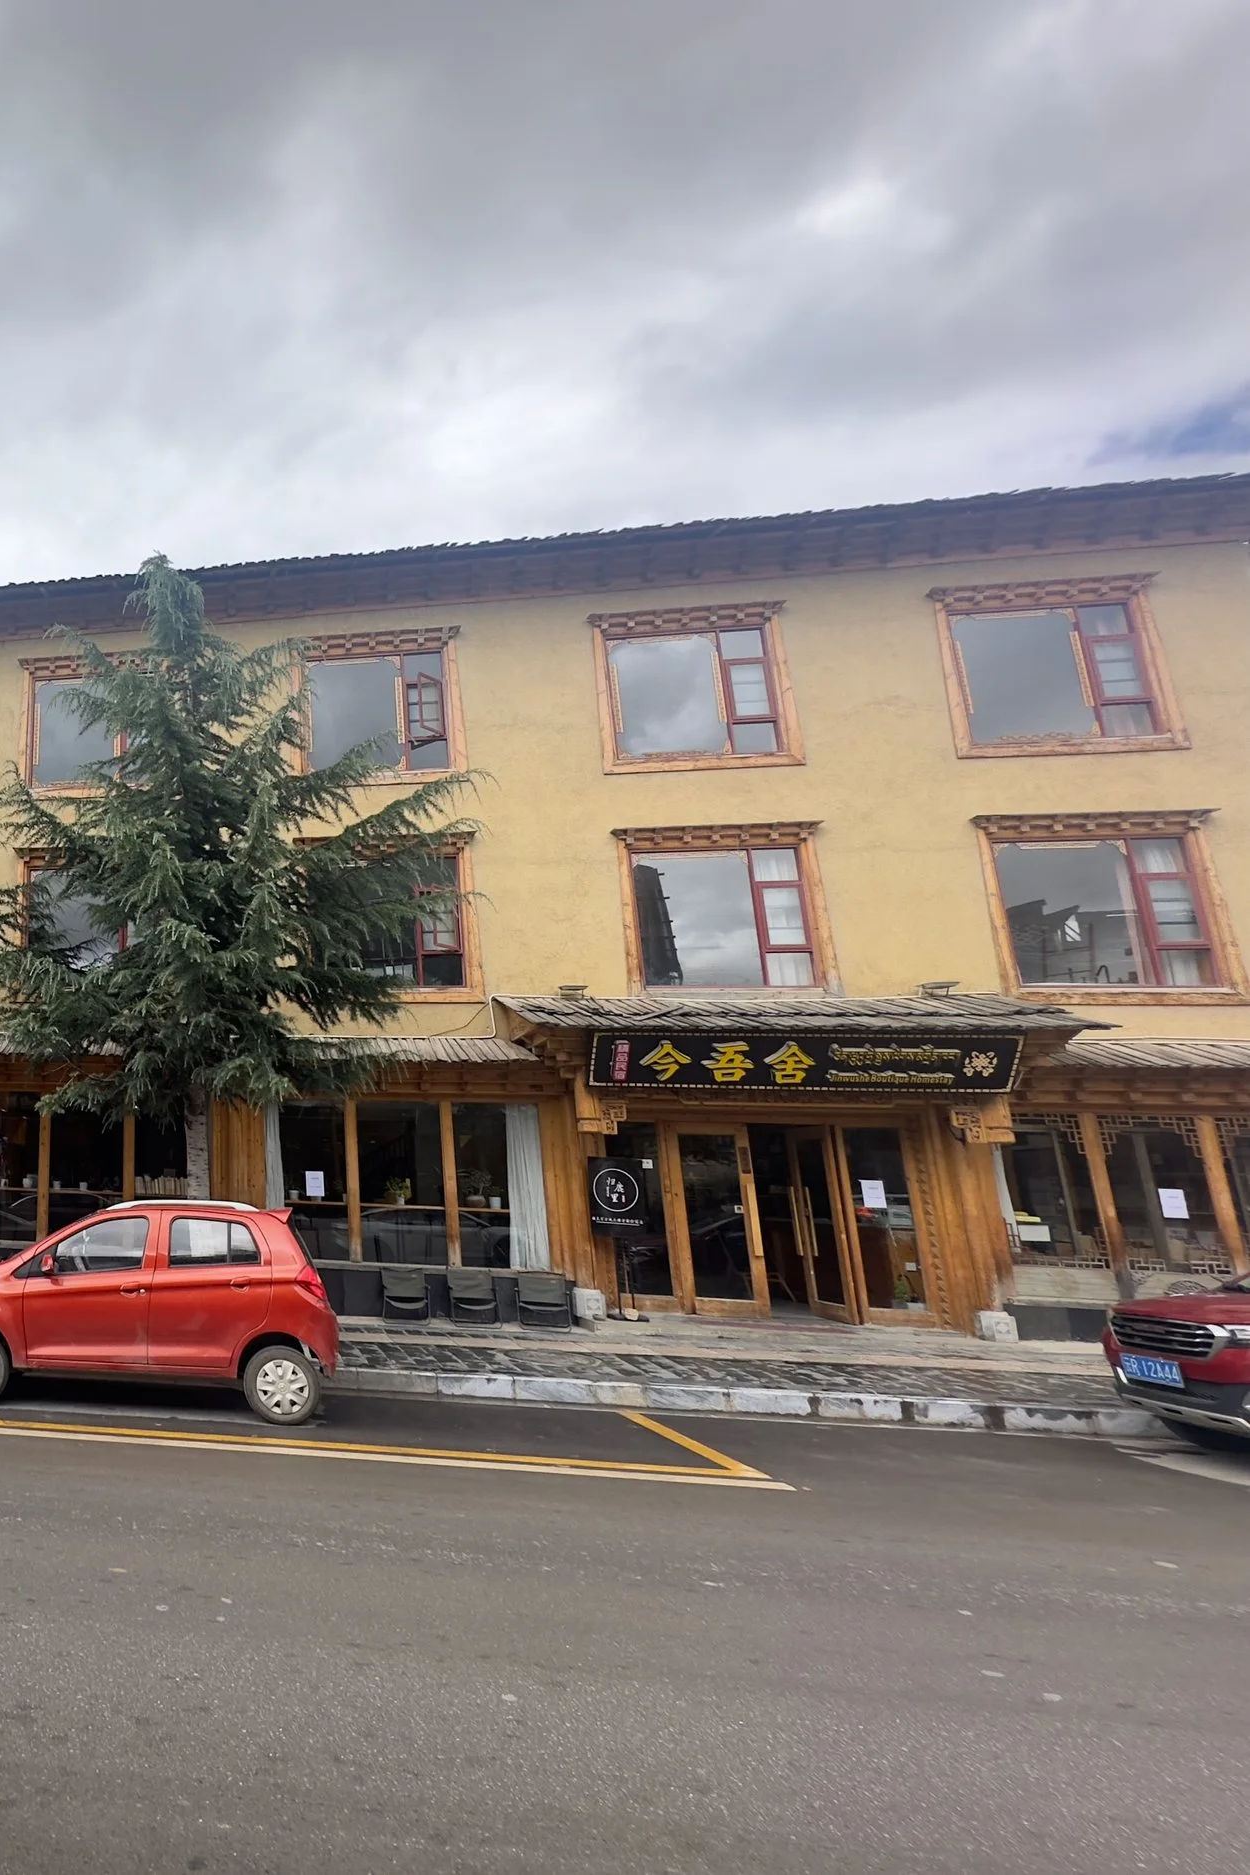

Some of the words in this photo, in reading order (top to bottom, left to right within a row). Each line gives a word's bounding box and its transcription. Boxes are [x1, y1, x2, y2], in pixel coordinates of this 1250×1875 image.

[639, 1040, 816, 1084] 今吾舍
[830, 1074, 870, 1083] Jinwushe
[871, 1075, 910, 1085] Boutique
[910, 1075, 954, 1085] Homestay
